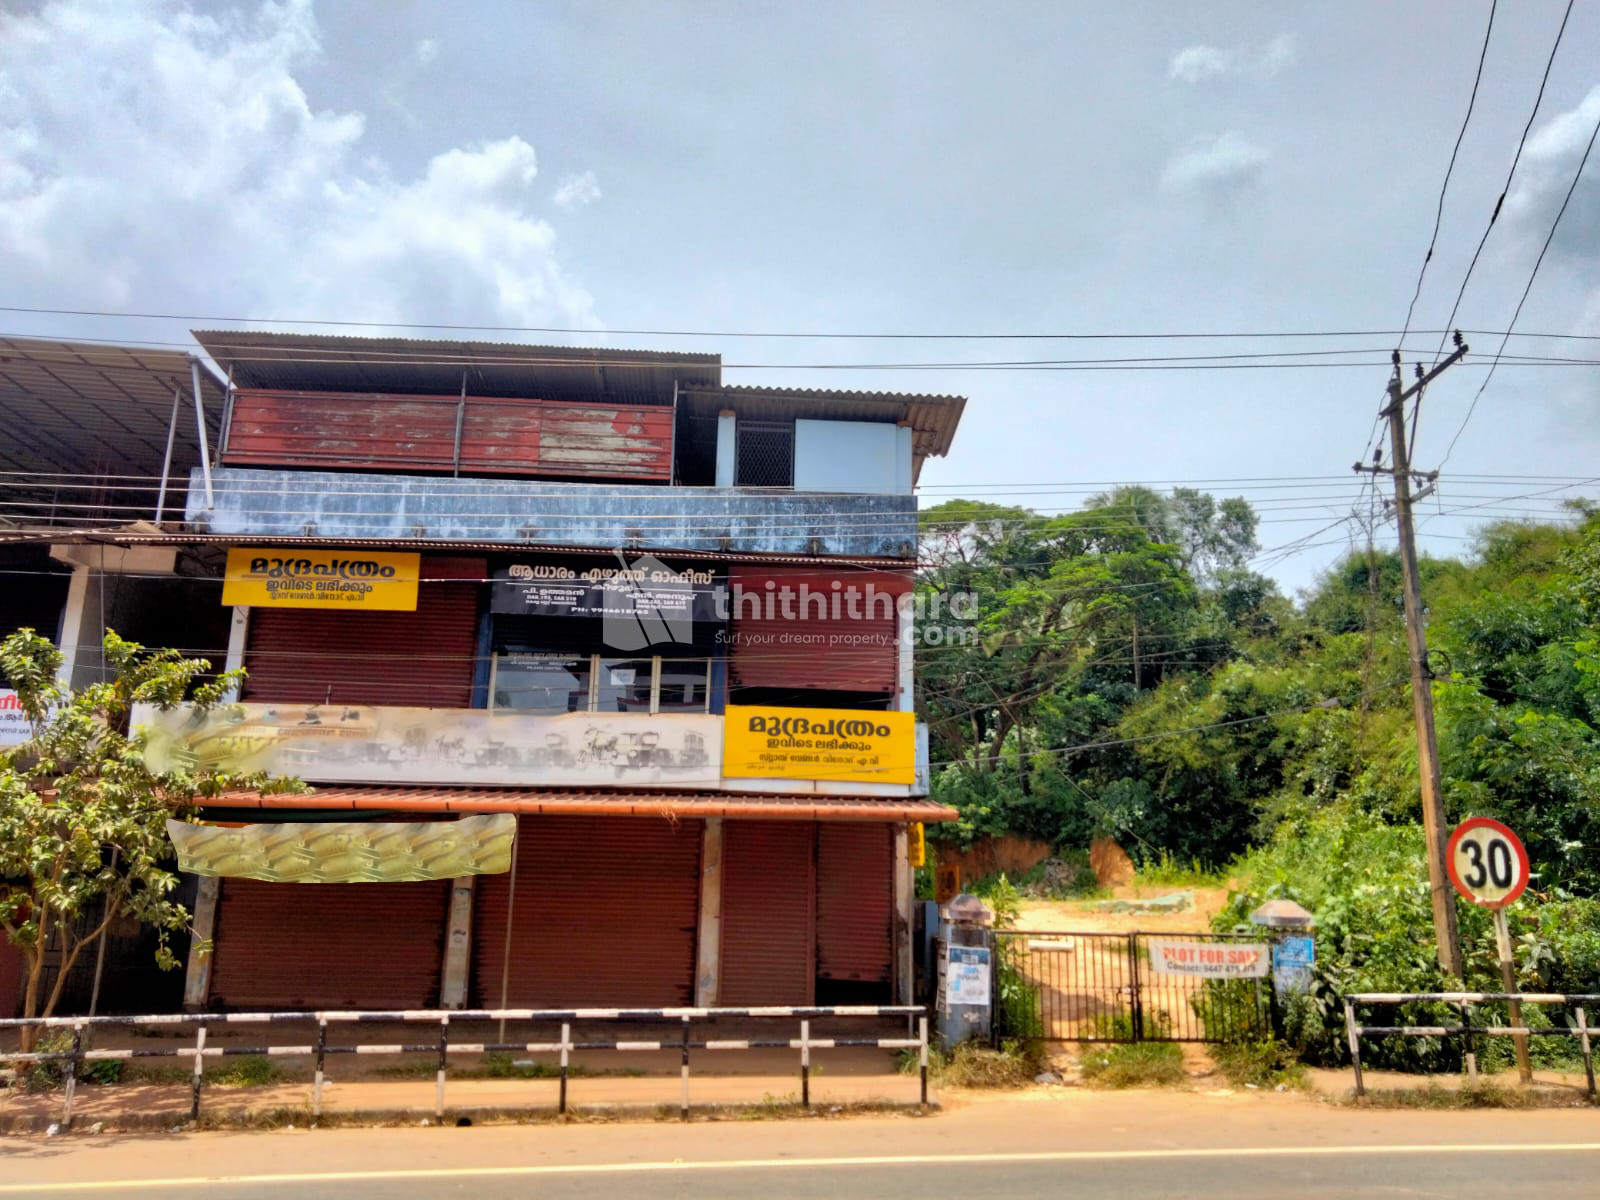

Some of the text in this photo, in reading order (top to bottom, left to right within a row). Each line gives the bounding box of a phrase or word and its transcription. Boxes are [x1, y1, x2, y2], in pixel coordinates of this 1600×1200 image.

[509, 565, 715, 585] ആധാരം എഴുത്ത് ഓഫീസ്
[266, 579, 373, 593] ഇവിടെ ലഭിക്കും
[748, 716, 892, 739] മുദ്രപത്രം
[766, 737, 872, 752] ഇവിടെ ലഭിക്കും
[1460, 838, 1513, 889] 30
[1199, 949, 1225, 964] FOR
